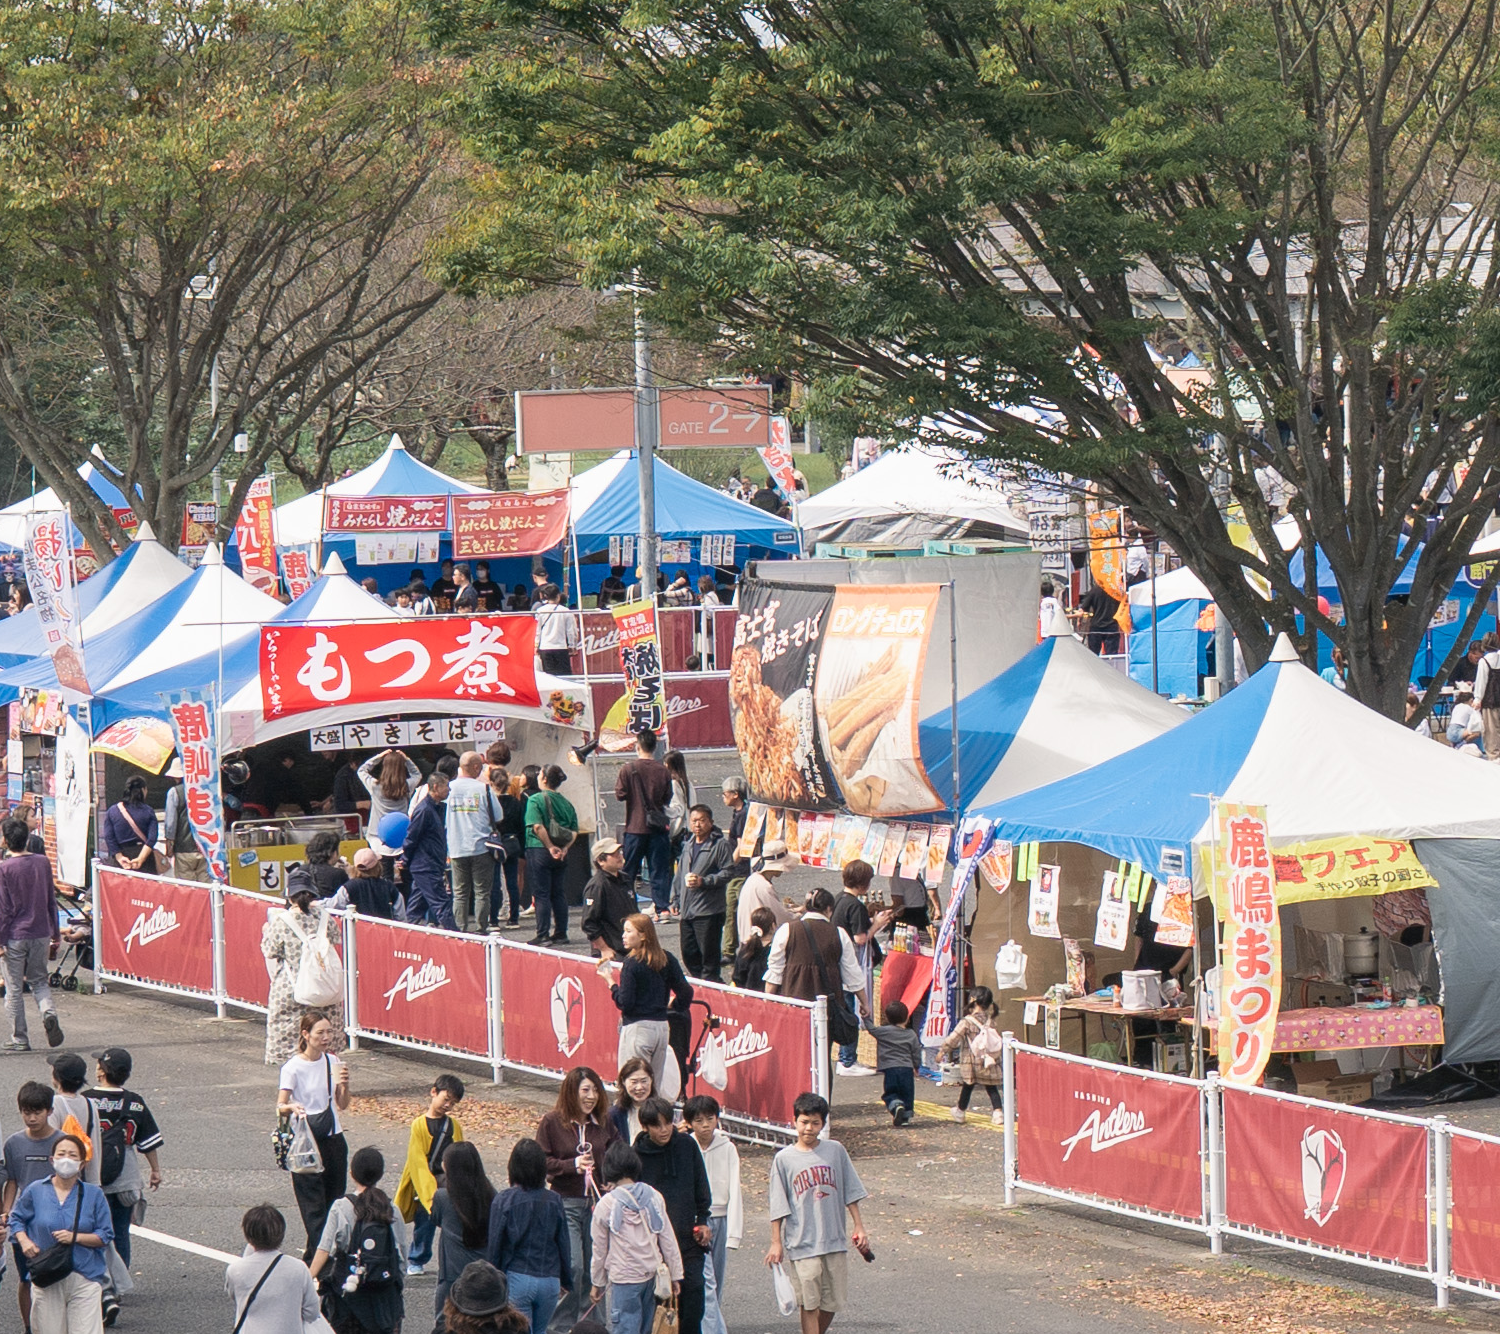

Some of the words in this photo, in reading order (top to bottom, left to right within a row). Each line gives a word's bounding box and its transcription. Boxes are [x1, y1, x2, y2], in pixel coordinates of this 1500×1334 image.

[669, 422, 704, 435] GATE
[708, 401, 730, 434] 2
[734, 600, 781, 648] 富士宮
[761, 609, 824, 665] 焼きそば
[831, 606, 926, 635] ロングチュロス
[296, 619, 516, 702] もつ煮
[312, 728, 342, 746] 大盛
[350, 719, 469, 747] やきそば
[124, 903, 182, 954] Antlers
[1229, 817, 1274, 1077] 鹿嶋まつり
[383, 954, 451, 1009] Antlers
[1059, 1101, 1154, 1162] Antlers
